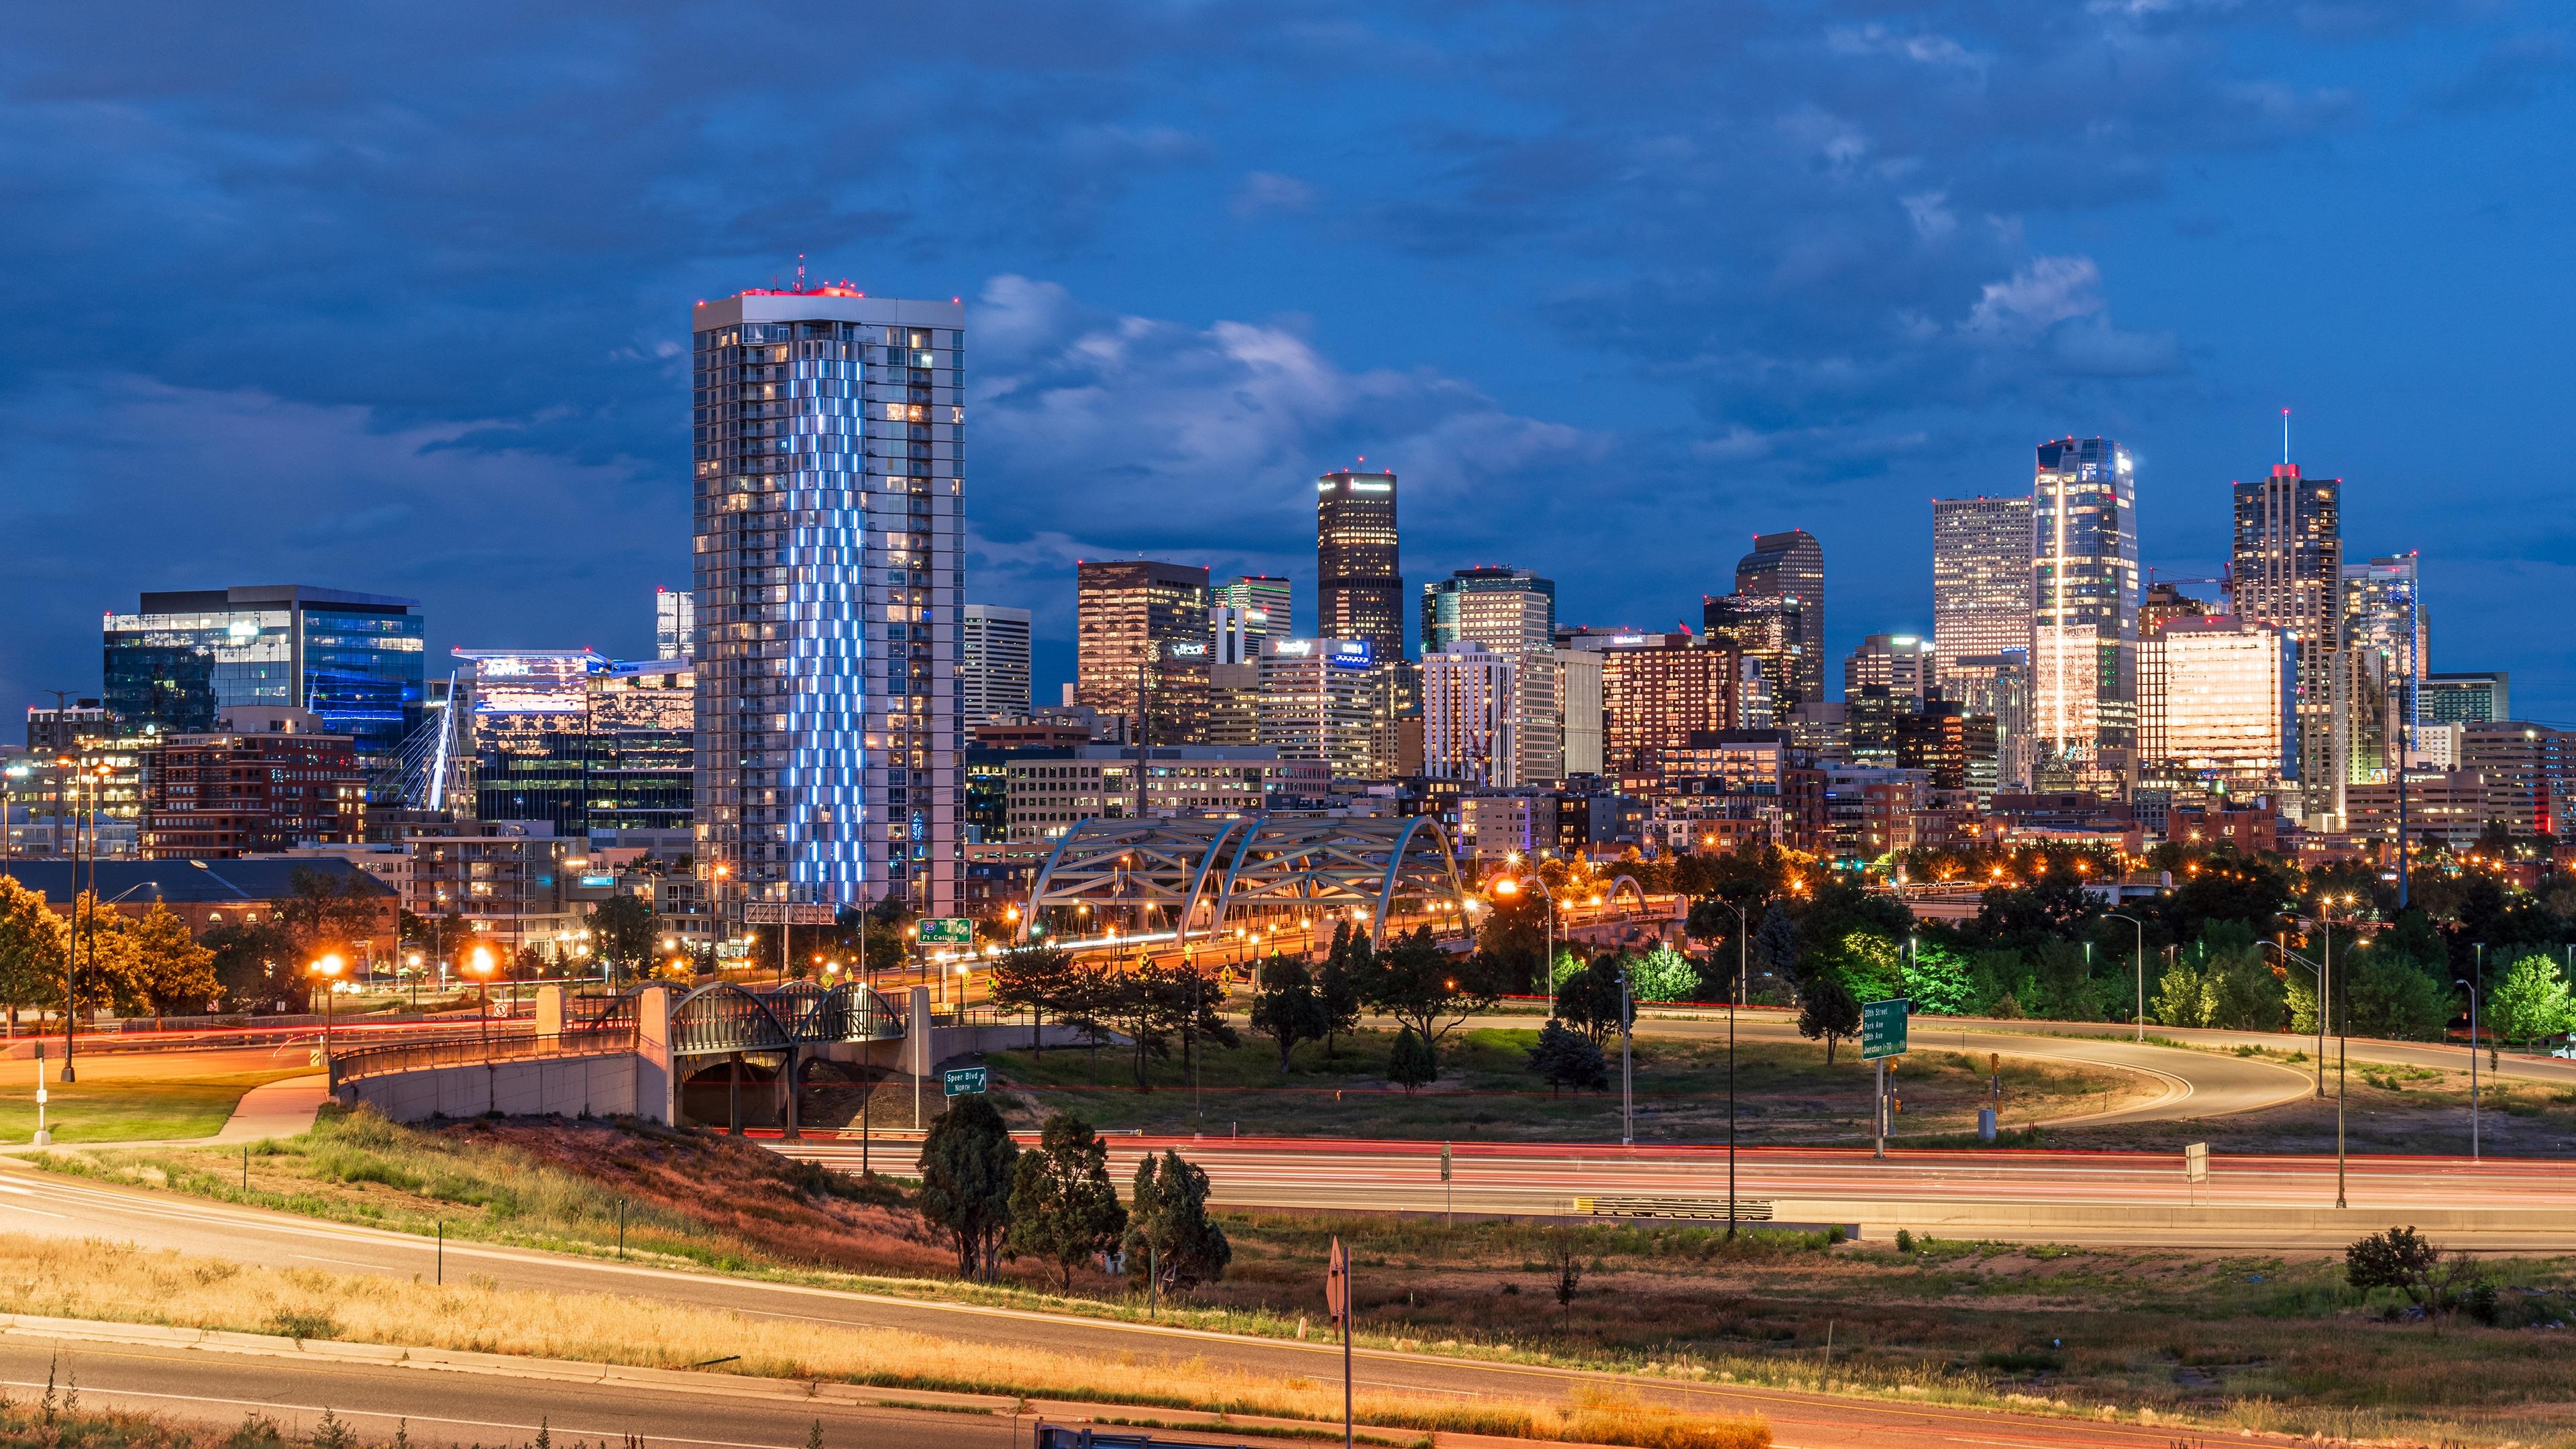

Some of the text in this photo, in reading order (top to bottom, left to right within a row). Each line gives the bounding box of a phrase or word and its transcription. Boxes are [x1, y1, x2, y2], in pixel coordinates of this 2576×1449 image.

[1275, 640, 1311, 655] Xactly
[1864, 1009, 1874, 1018] 20th
[1875, 1007, 1888, 1016] Street
[1864, 1022, 1874, 1030] Park
[1864, 1032, 1883, 1042] 38th Ave
[1864, 1044, 1882, 1054] Junction
[1883, 1042, 1892, 1051] I-70
[947, 1071, 978, 1083] Speer Blvd
